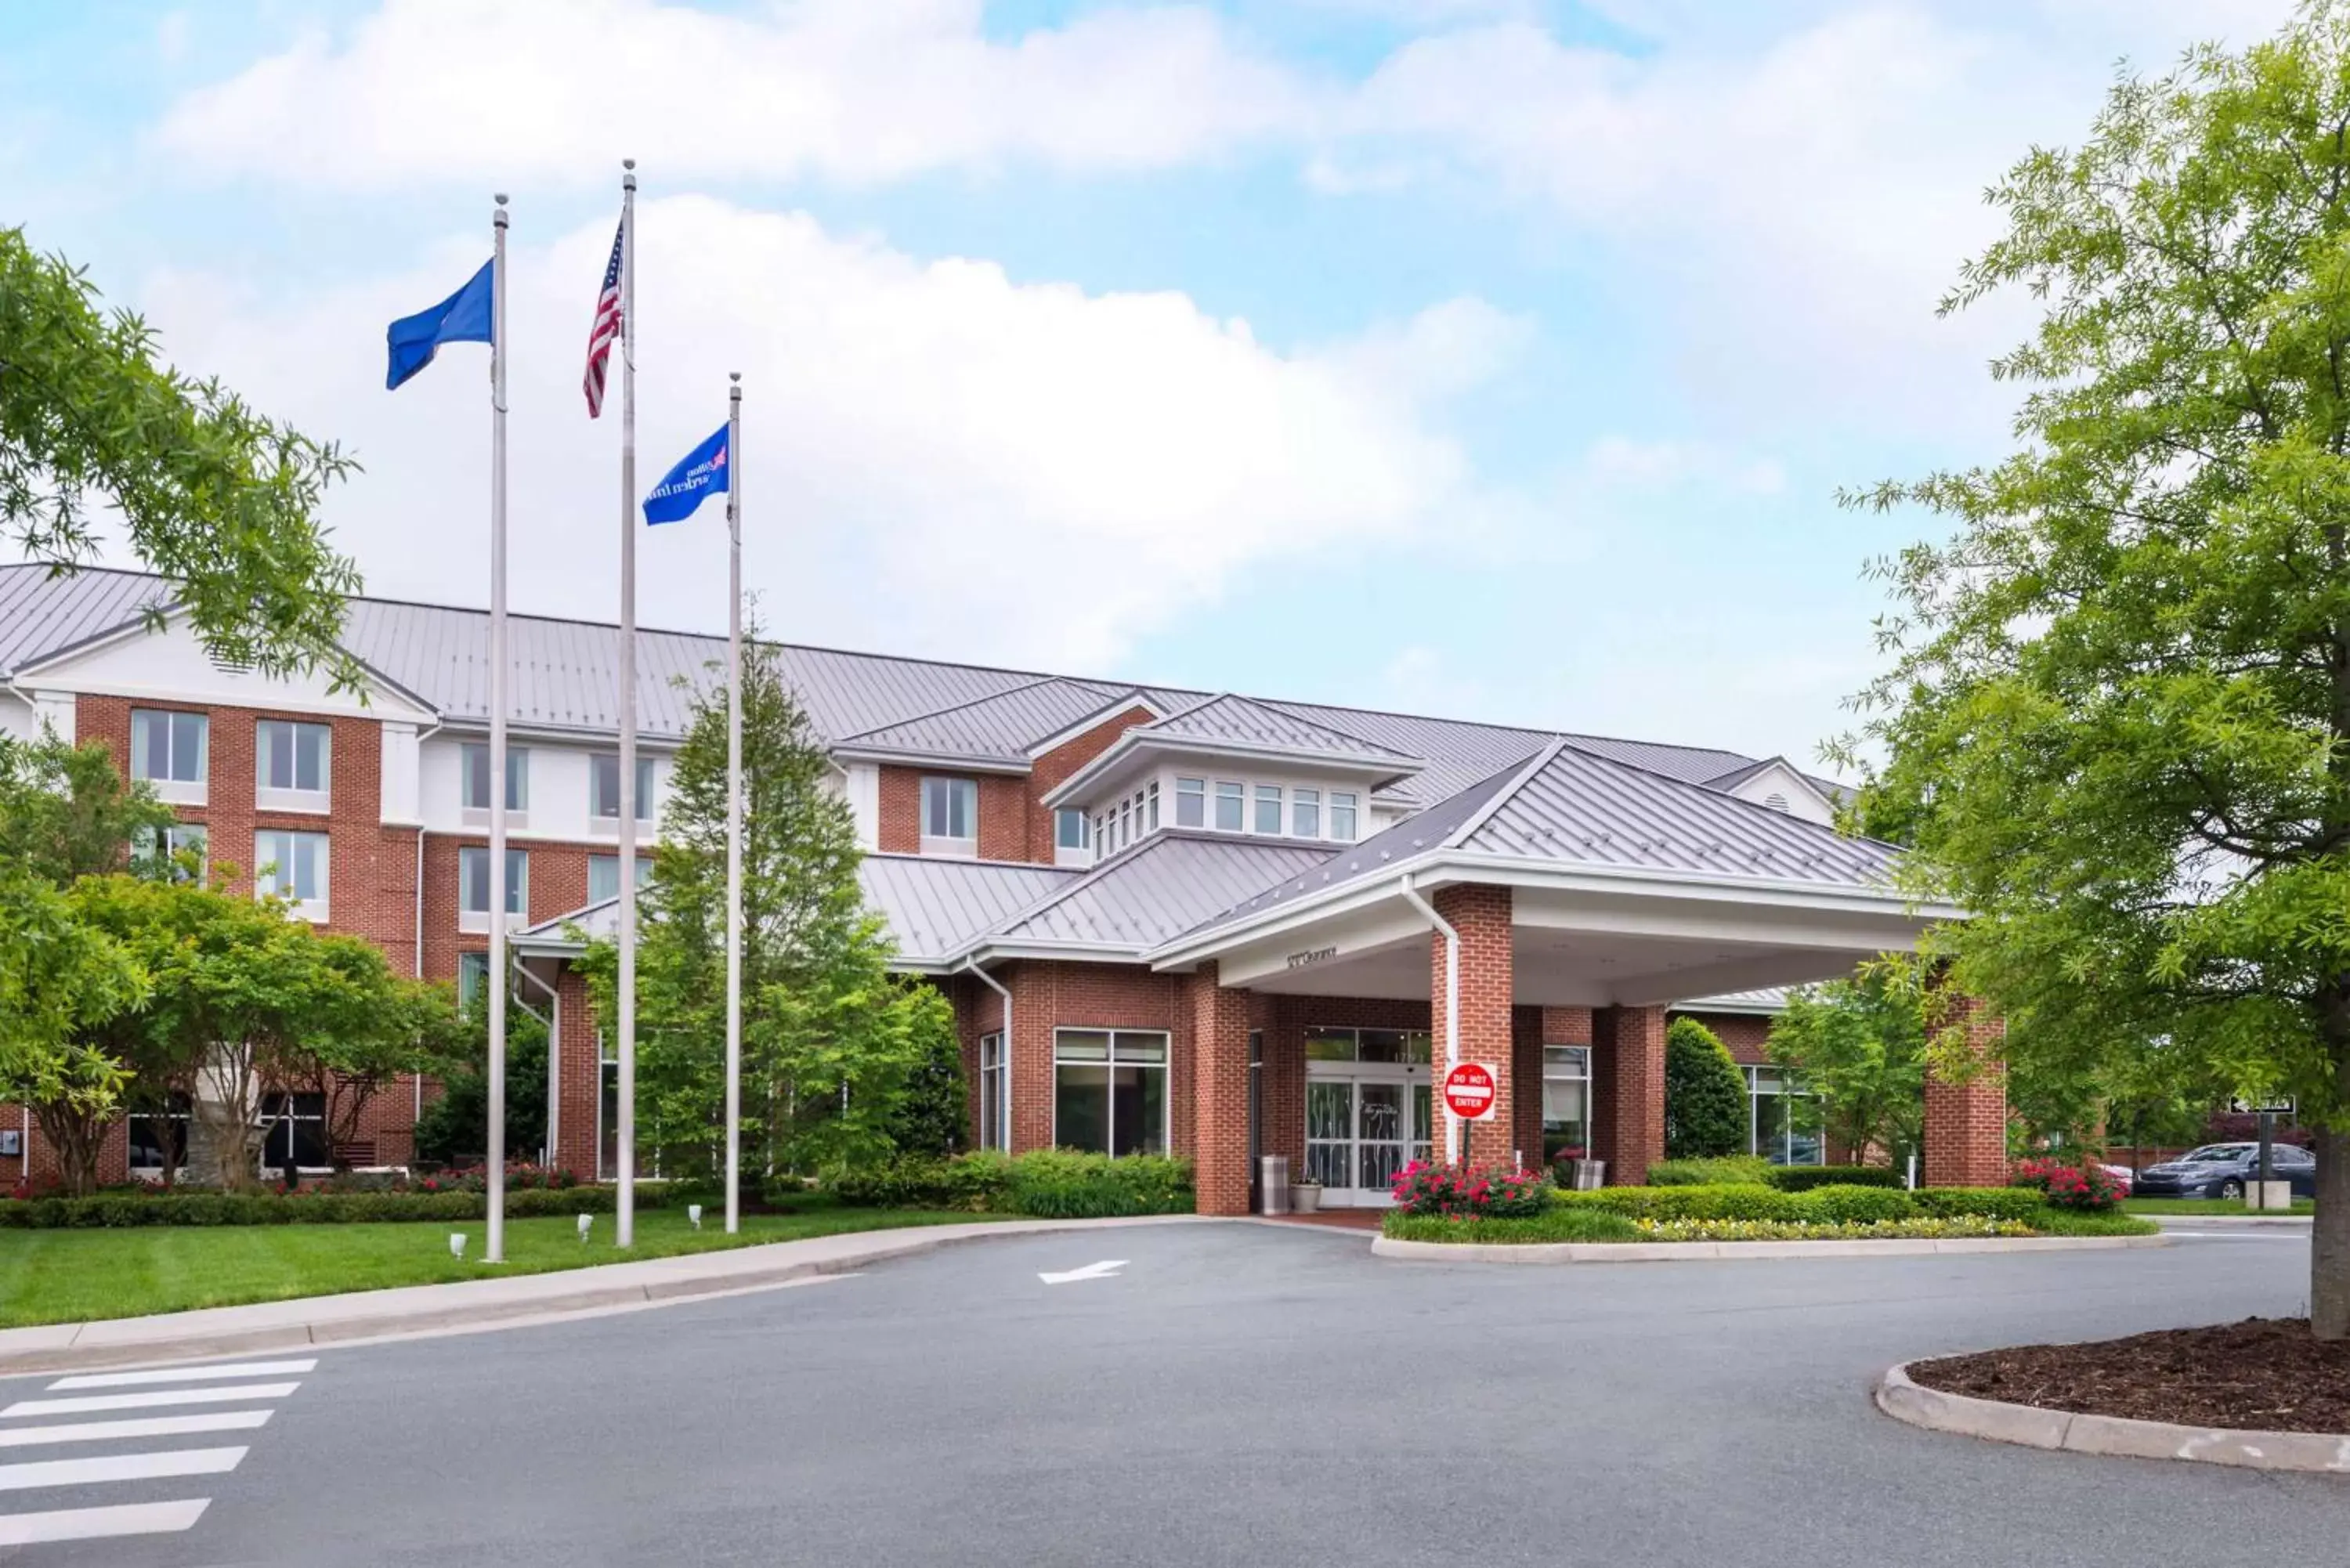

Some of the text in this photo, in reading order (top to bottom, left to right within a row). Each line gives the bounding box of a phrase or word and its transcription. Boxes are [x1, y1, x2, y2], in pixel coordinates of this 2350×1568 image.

[1453, 1074, 1488, 1085] DO NOT
[1455, 1098, 1483, 1107] ENTER
